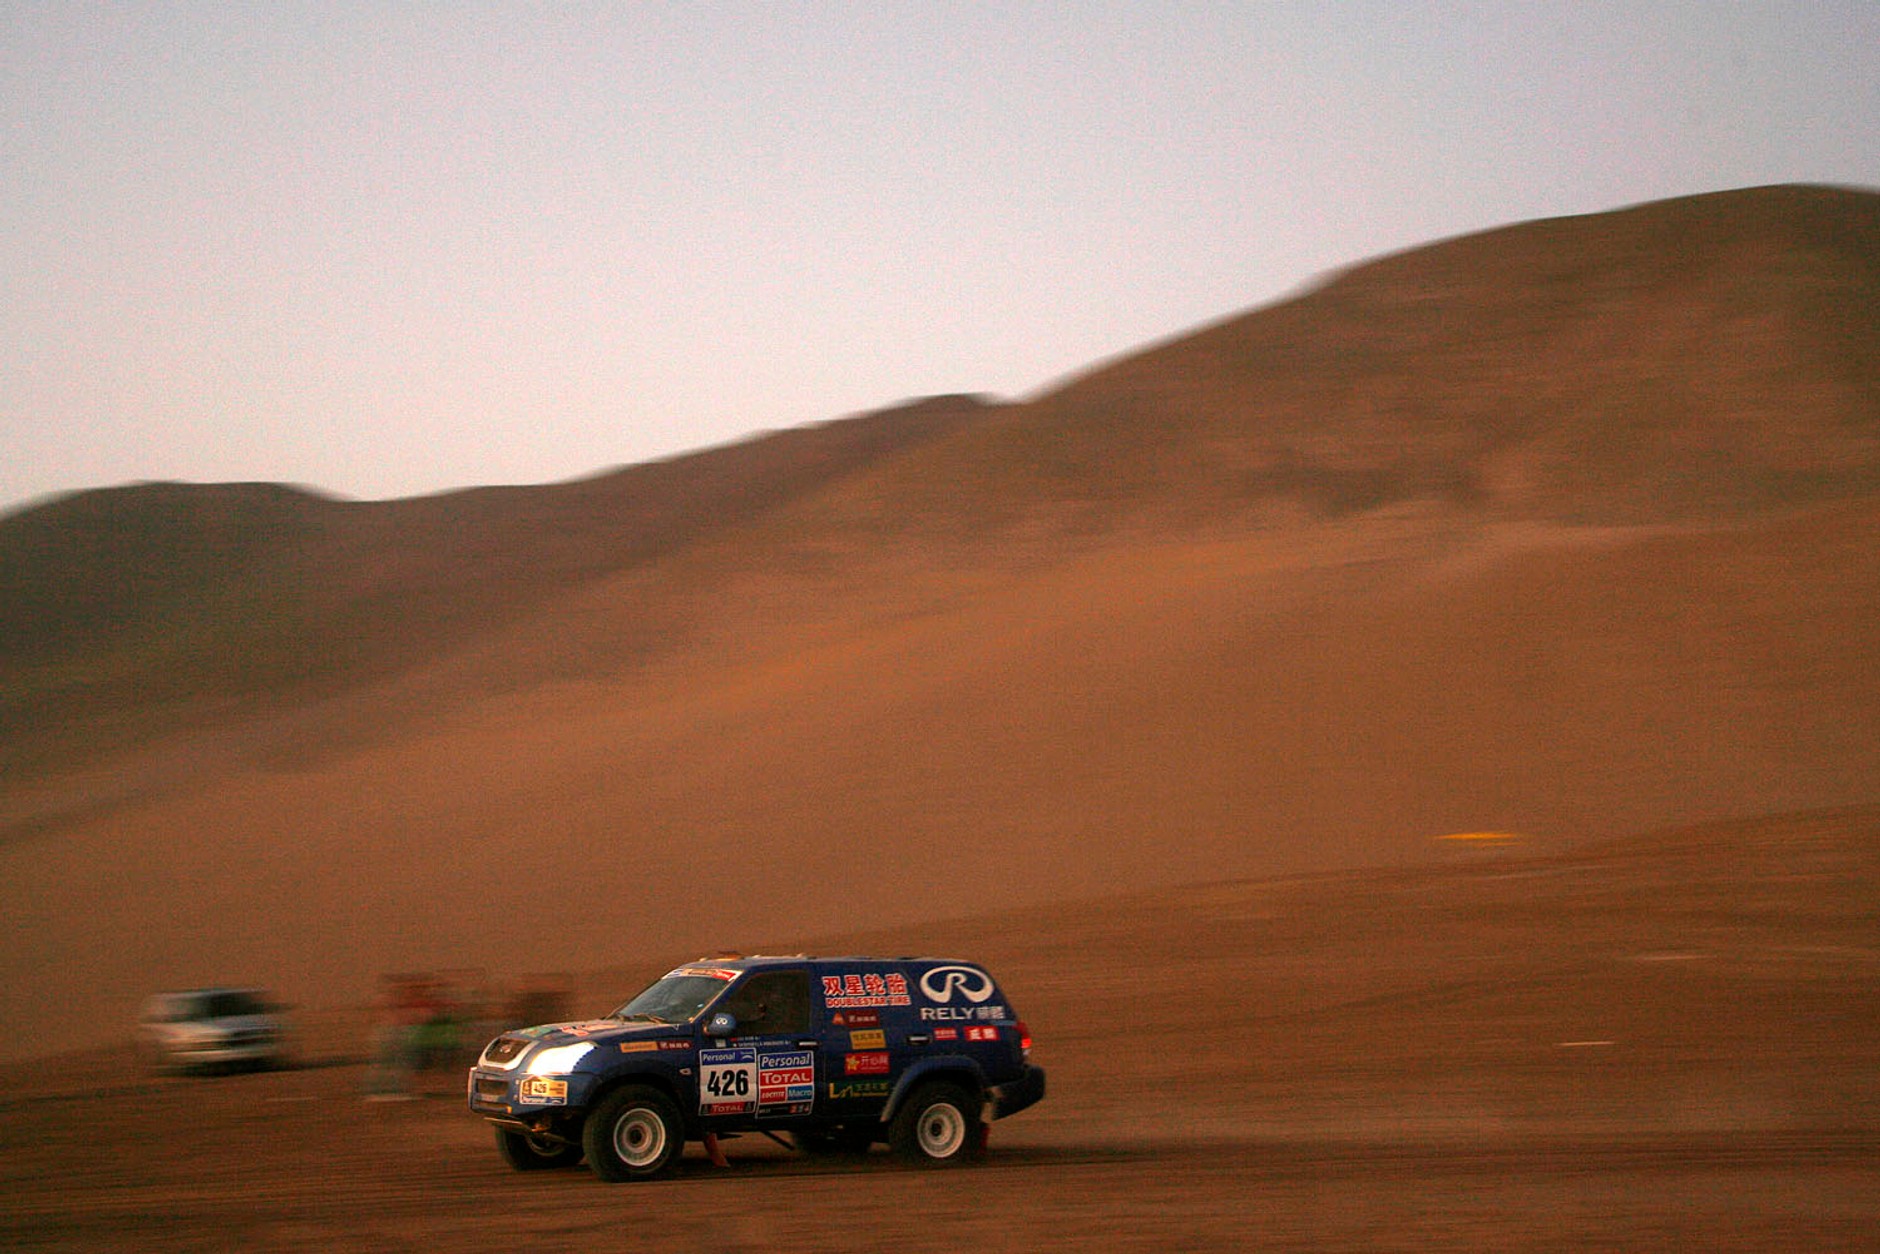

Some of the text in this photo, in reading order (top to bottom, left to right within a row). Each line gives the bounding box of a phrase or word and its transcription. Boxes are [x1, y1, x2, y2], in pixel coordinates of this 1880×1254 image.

[822, 974, 907, 996] 双星轮胎
[825, 997, 887, 1008] DOUBLESTAR
[920, 1007, 974, 1020] RELY
[703, 1052, 735, 1061] Personal
[761, 1054, 810, 1067] Personal
[707, 1069, 749, 1097] 426
[762, 1072, 811, 1084] TOTAL
